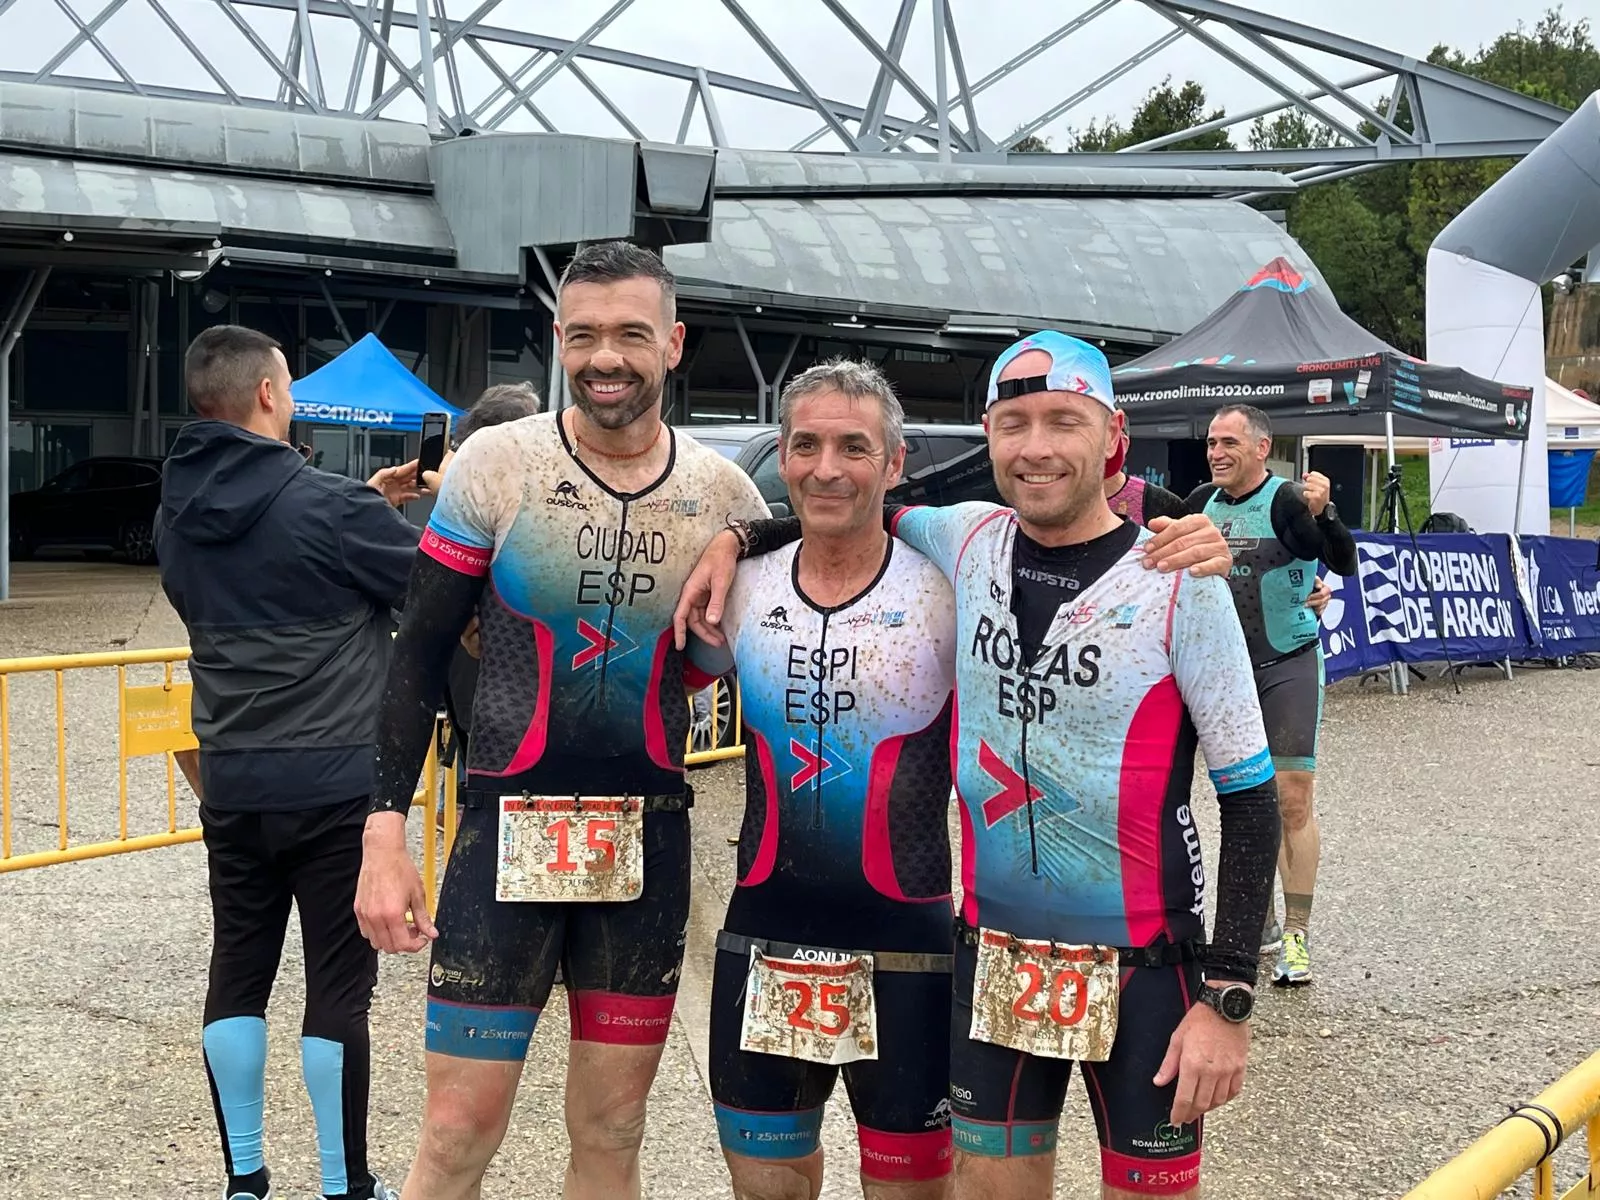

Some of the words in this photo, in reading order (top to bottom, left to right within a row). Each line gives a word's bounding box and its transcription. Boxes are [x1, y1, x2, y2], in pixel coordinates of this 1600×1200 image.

[1296, 360, 1358, 373] CRONOLIMITS
[1360, 357, 1381, 368] LIVE
[576, 523, 667, 565] CIUDAD
[576, 569, 656, 607] ESP
[1400, 549, 1500, 594] GOBIERNO
[1402, 597, 1440, 639] DE
[787, 644, 858, 682] ESPI
[785, 688, 856, 726] ESP
[998, 674, 1056, 725] ESP
[546, 818, 616, 873] 15
[1176, 804, 1205, 926] treme
[783, 981, 850, 1036] 25
[1012, 962, 1088, 1027] 20
